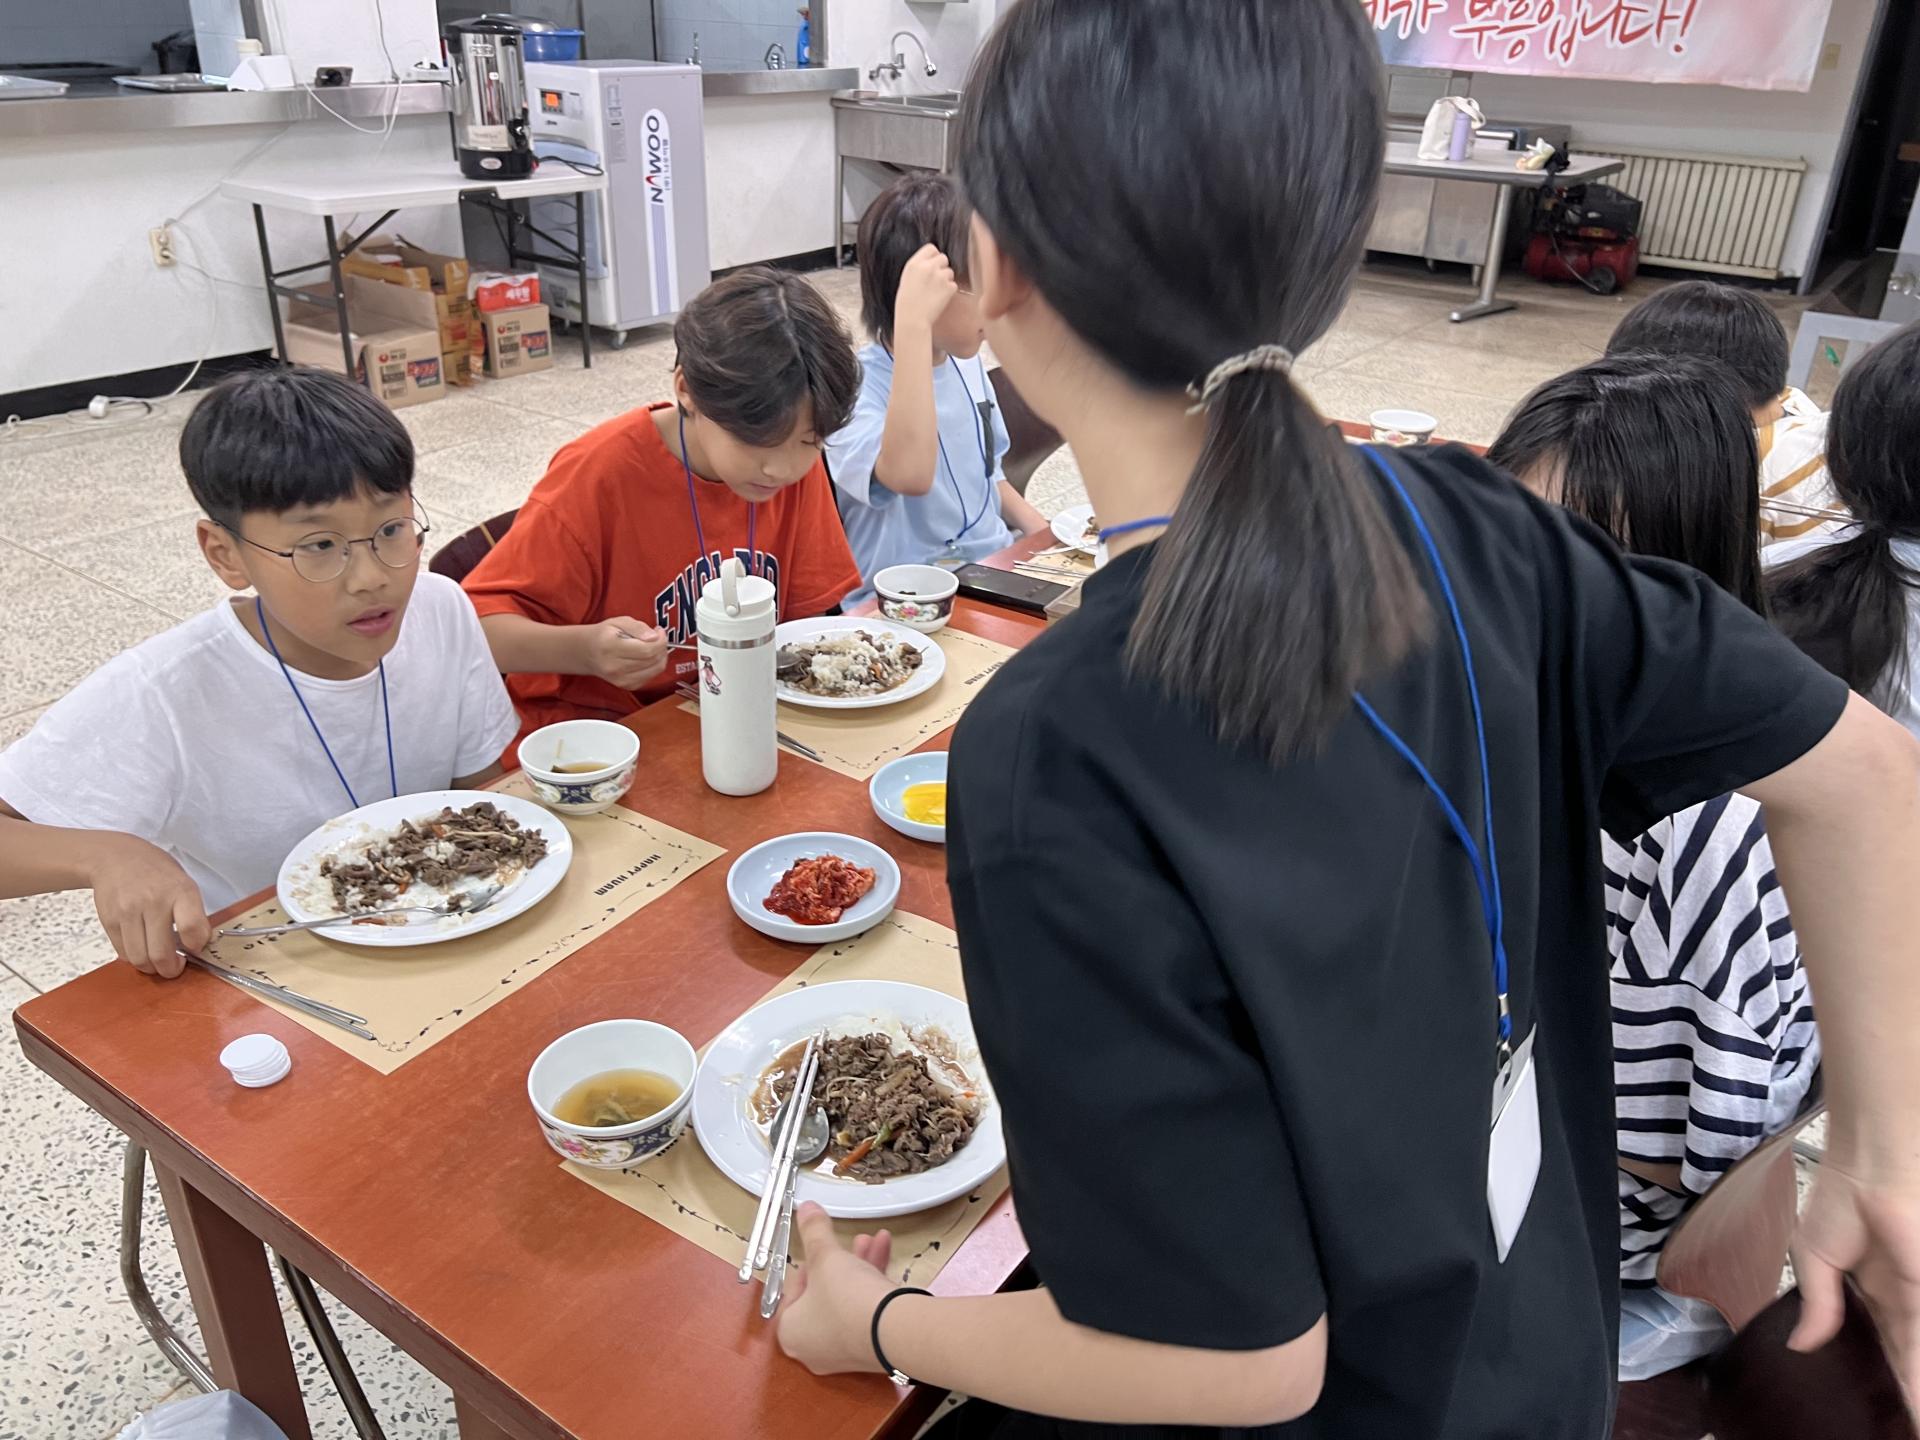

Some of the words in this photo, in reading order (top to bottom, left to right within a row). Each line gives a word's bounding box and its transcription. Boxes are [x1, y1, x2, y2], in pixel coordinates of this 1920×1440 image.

[1451, 0, 1698, 63] 부흥입니다!
[645, 115, 664, 204] NAWOO
[627, 853, 662, 877] HAPPY
